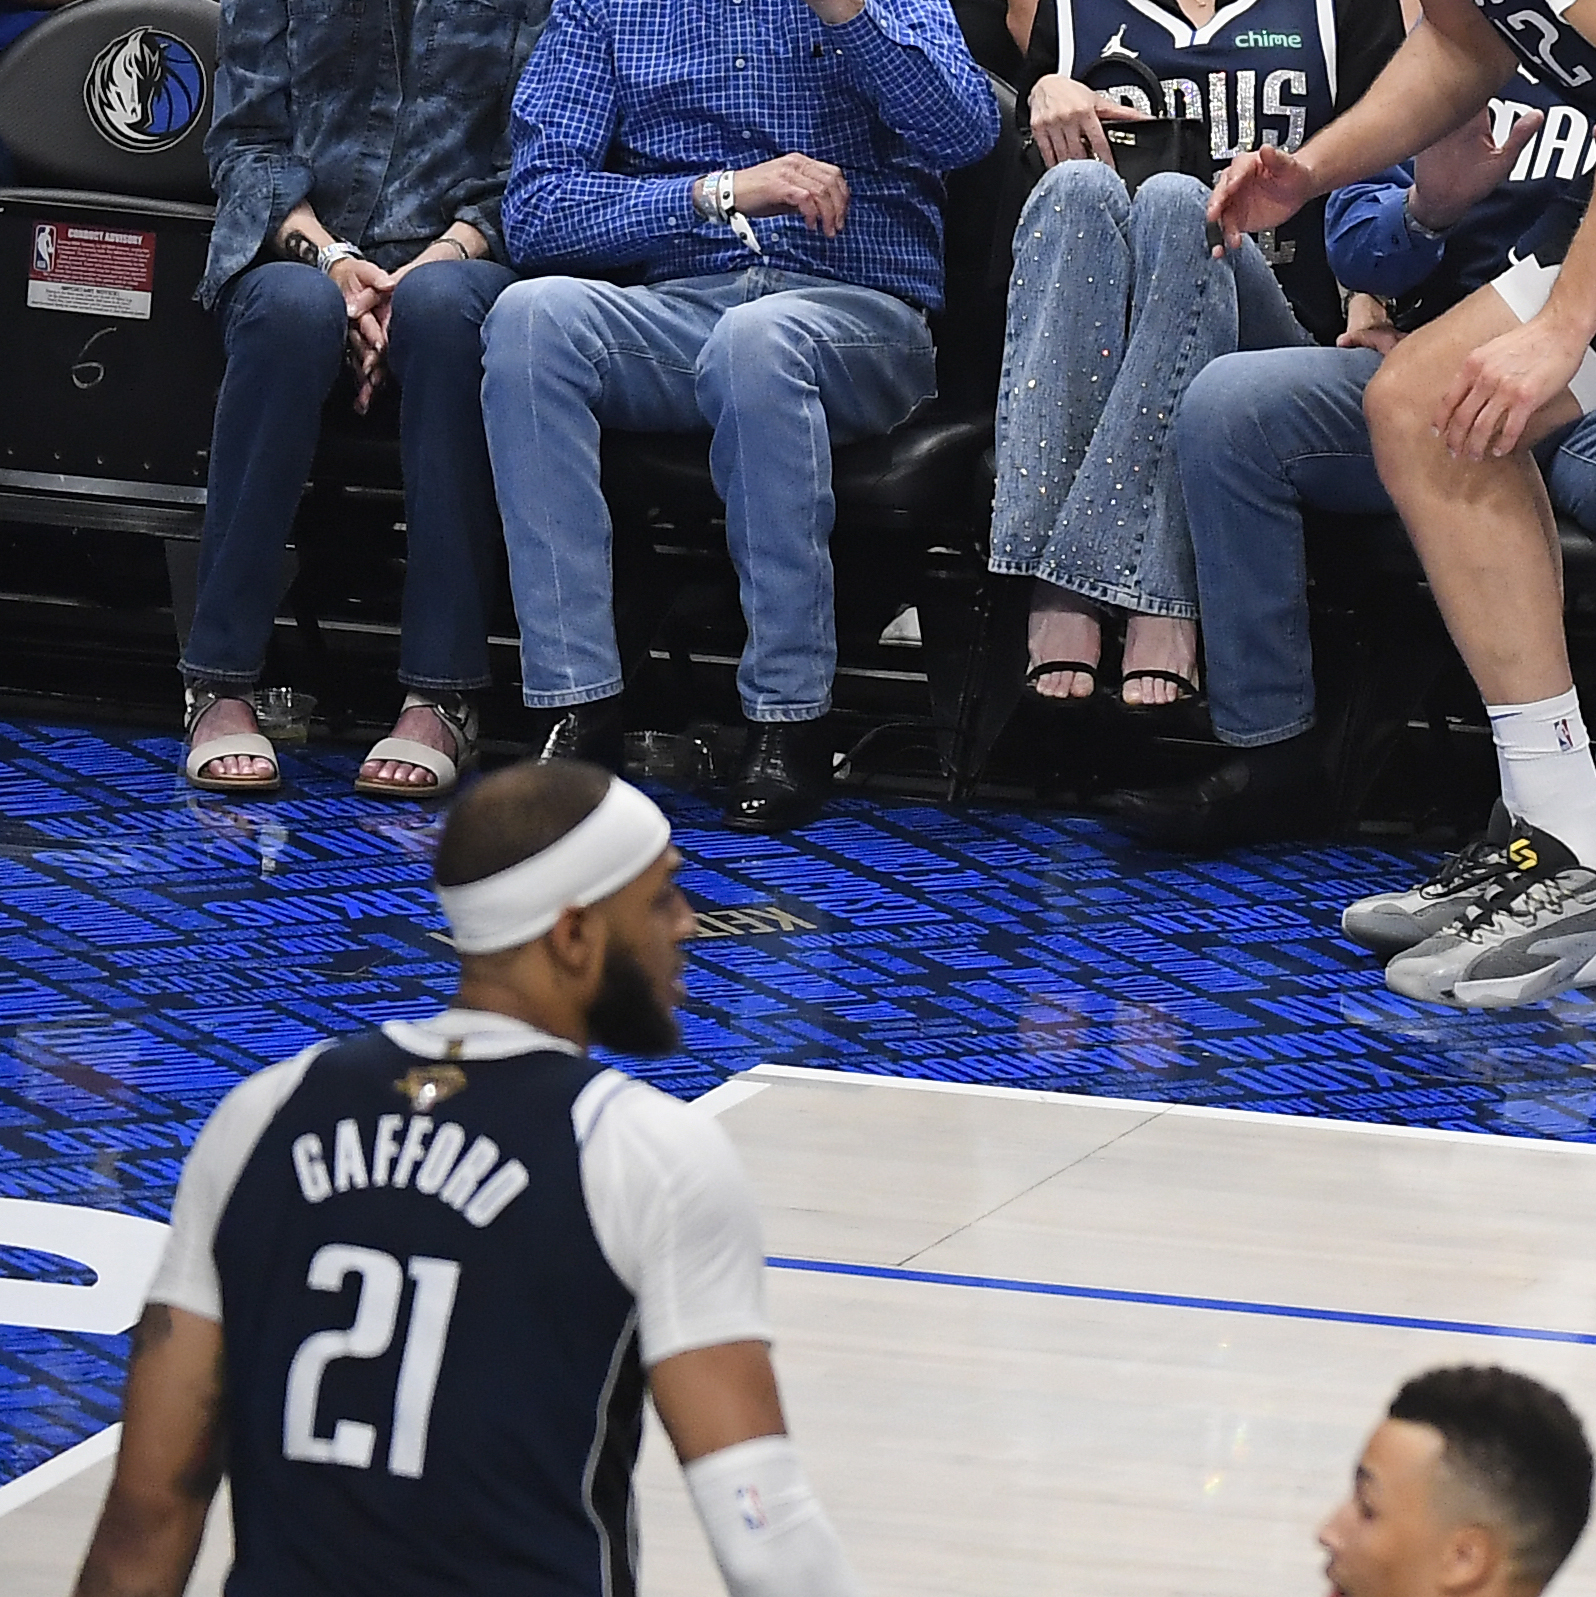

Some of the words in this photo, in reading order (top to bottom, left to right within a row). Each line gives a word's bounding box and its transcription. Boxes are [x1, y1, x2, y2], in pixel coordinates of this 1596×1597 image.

[1234, 29, 1303, 50] chime
[187, 886, 477, 926] ERKINS
[700, 853, 969, 926] DESAGANA
[1119, 904, 1323, 934] GREEN
[263, 933, 366, 961] TOM
[1066, 927, 1209, 962] REEVES
[115, 967, 248, 996] LEVER
[1193, 1027, 1392, 1062] JAMAL
[1216, 1058, 1420, 1096] KIDD
[291, 1112, 530, 1229] GAFFORD
[281, 1243, 462, 1480] 21
